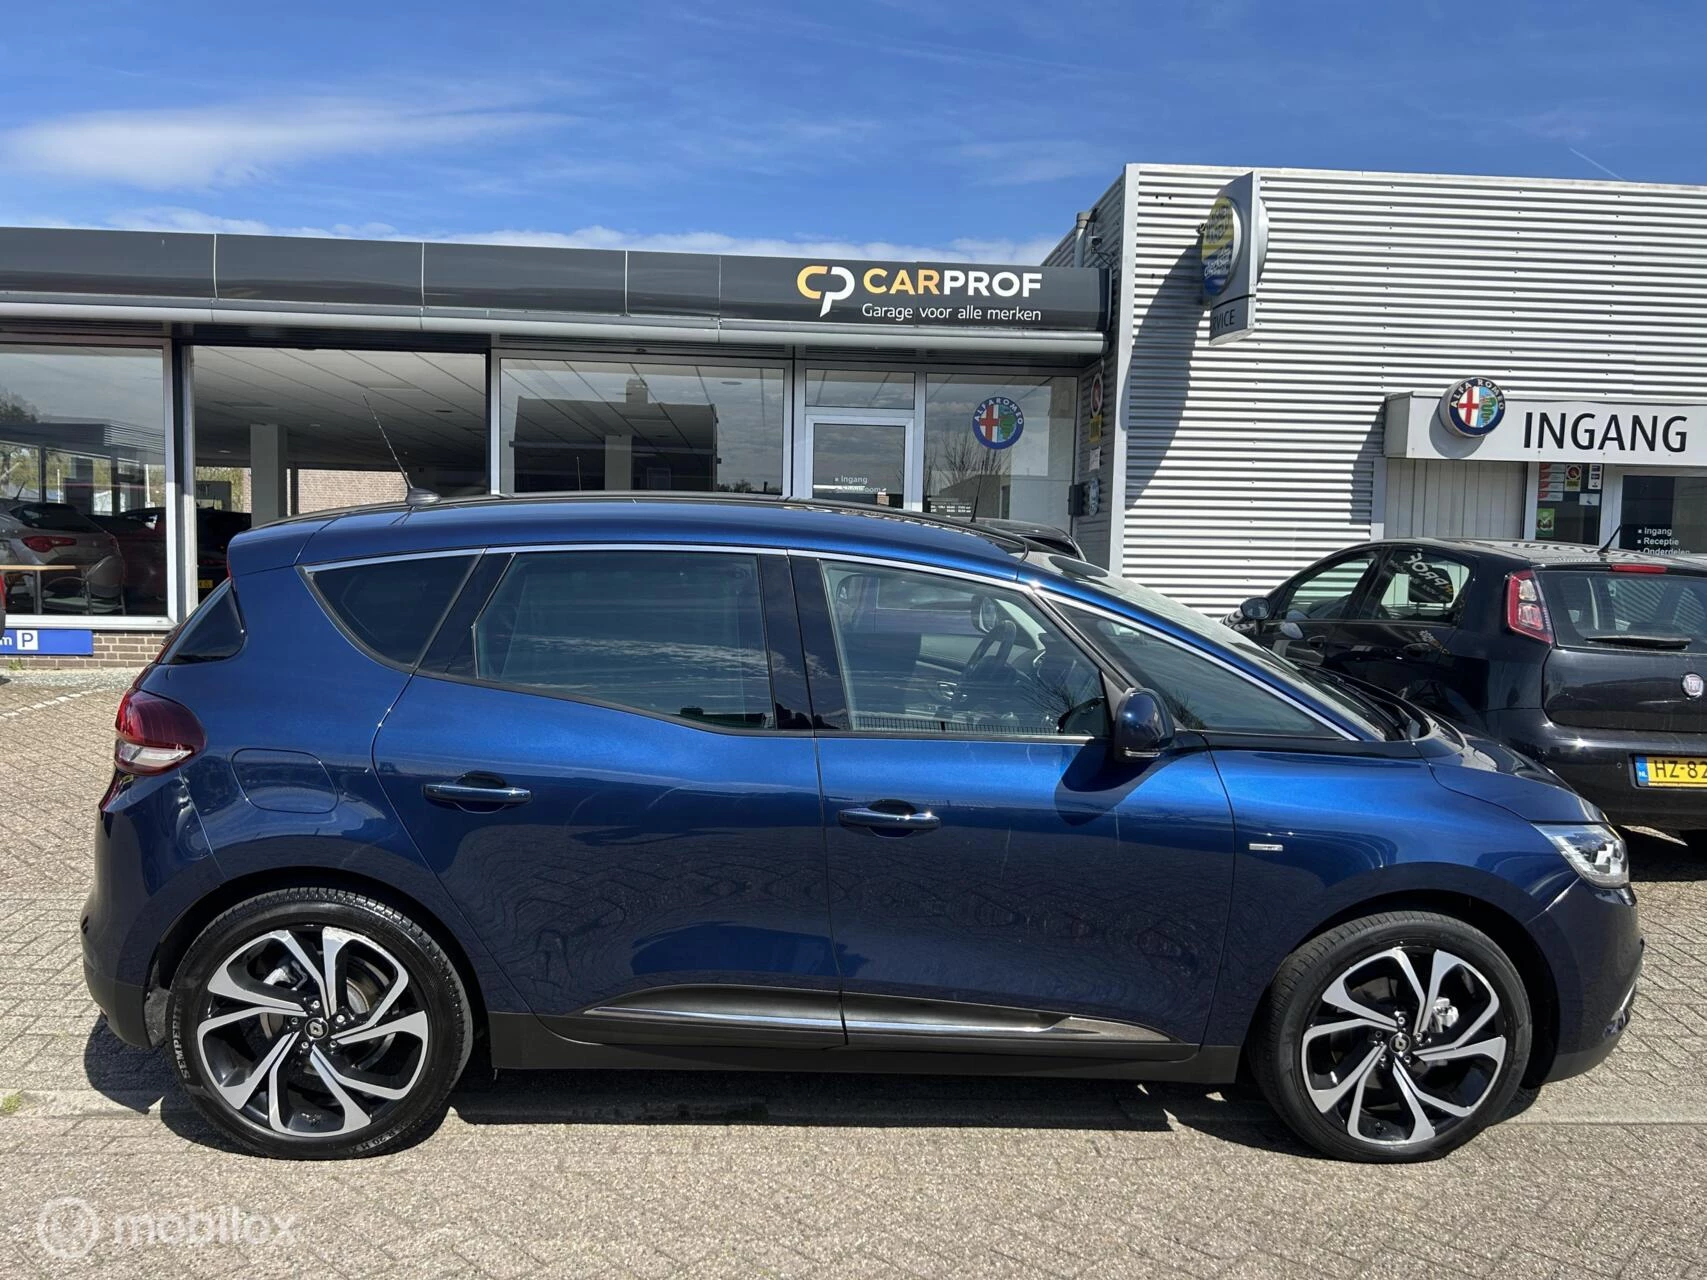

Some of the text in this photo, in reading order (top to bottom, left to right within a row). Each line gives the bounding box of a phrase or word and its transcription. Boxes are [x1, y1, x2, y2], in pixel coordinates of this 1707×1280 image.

[863, 267, 1043, 297] CARPROF
[862, 303, 1042, 321] Garage voor alle merken
[1450, 382, 1472, 408] ALFA
[1523, 411, 1688, 453] INGANG
[840, 475, 868, 485] Ingang
[1643, 527, 1672, 537] Ingang
[1643, 537, 1680, 546] Receptie
